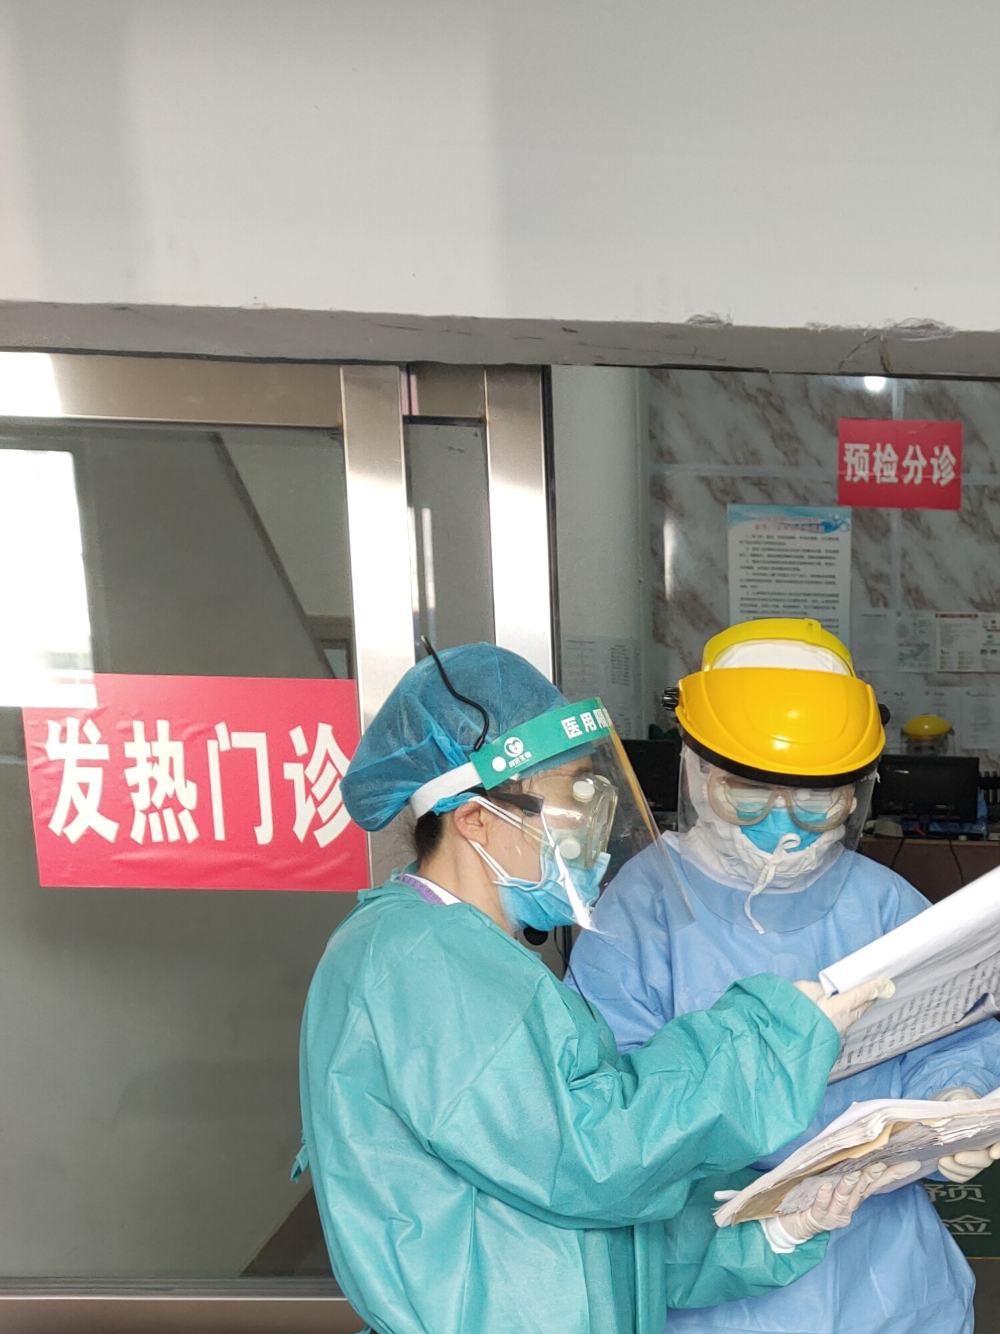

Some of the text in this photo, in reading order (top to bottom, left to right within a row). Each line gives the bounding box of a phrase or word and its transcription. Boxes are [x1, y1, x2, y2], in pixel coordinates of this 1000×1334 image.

[843, 442, 957, 486] 预检分诊
[45, 717, 350, 848] 发热门诊
